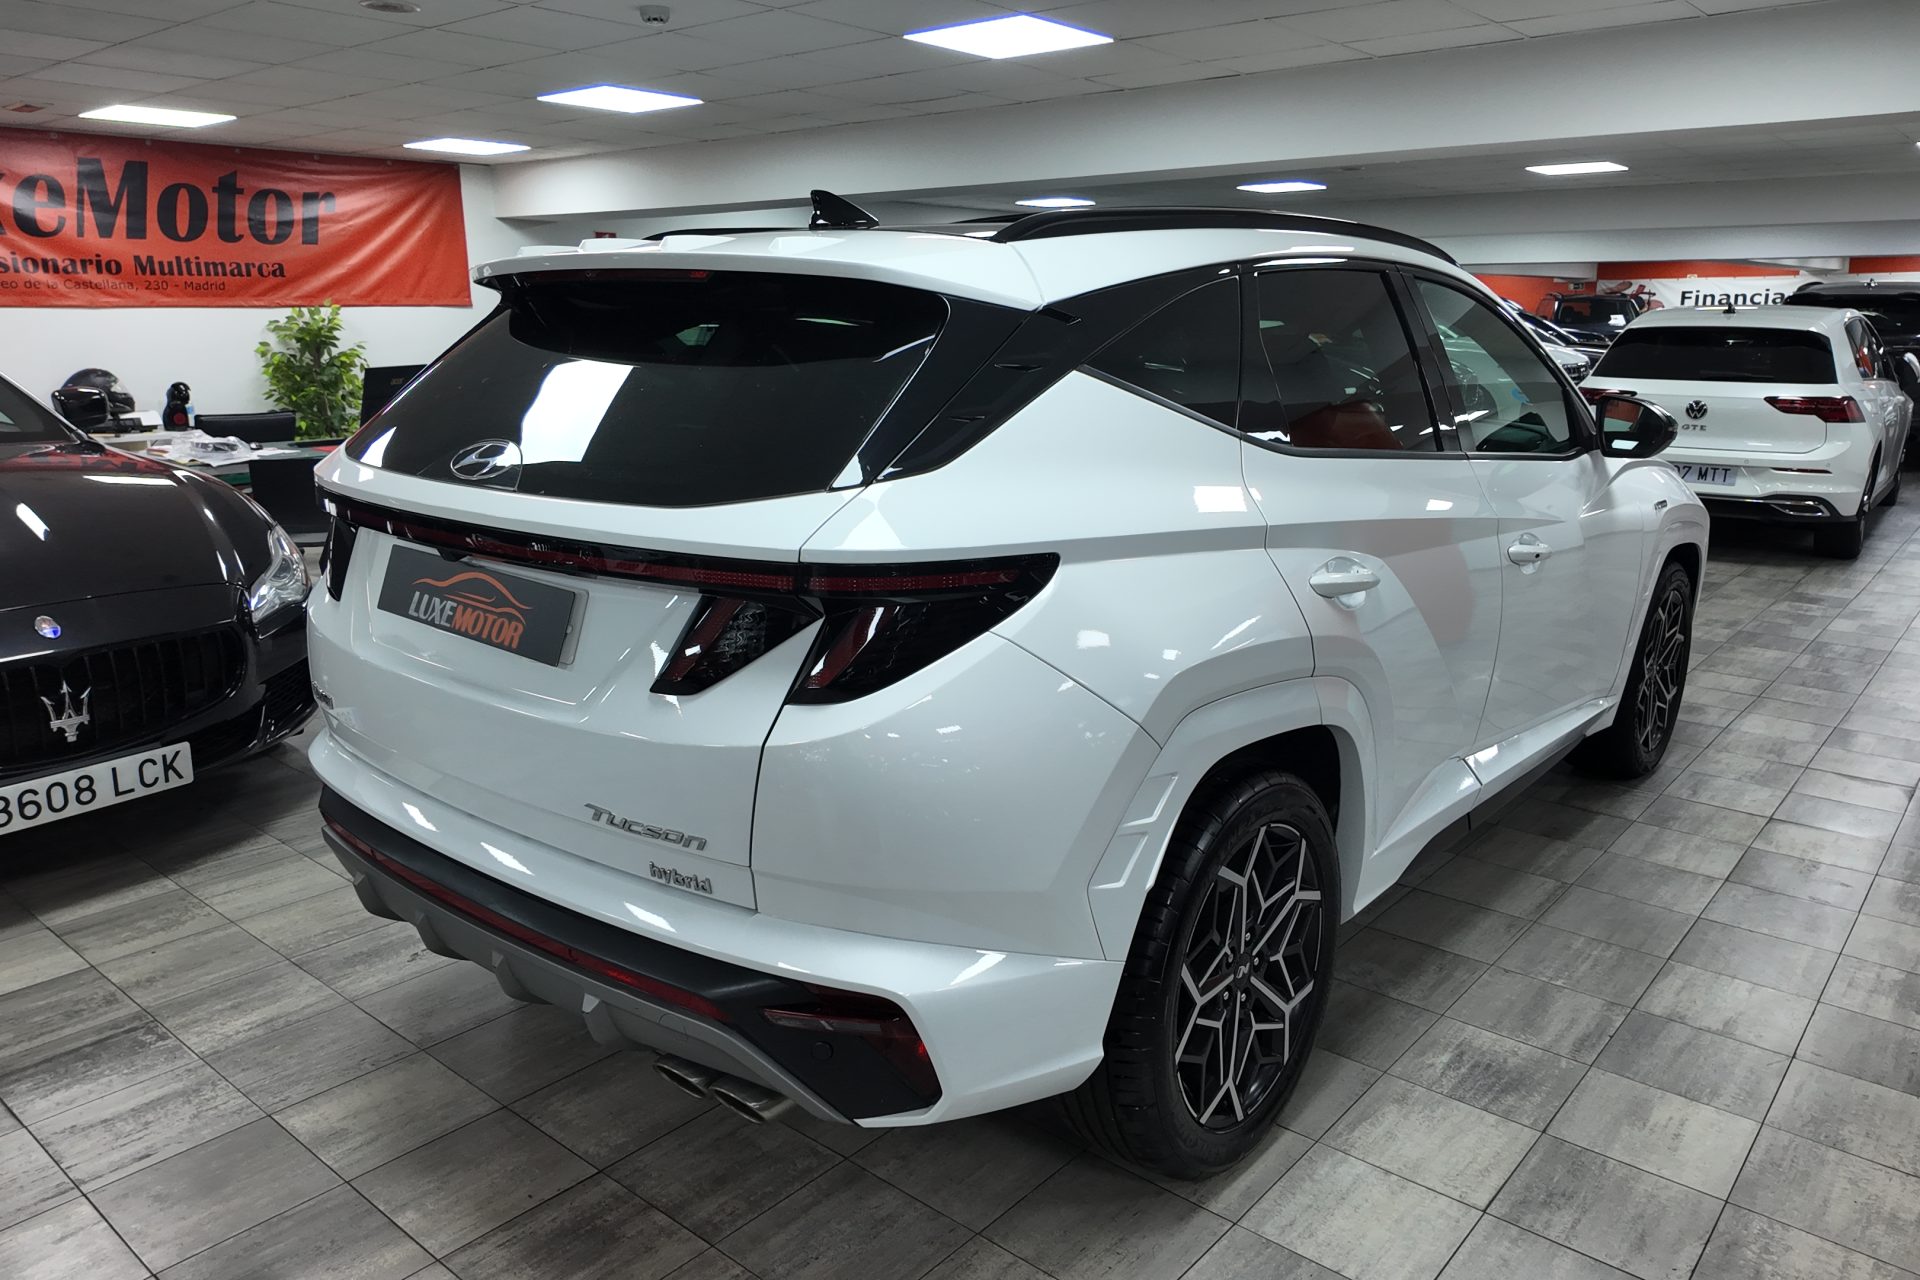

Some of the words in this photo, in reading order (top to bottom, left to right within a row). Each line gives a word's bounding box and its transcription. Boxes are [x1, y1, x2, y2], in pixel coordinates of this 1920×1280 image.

[0, 157, 336, 245] eMotor
[133, 255, 286, 278] Multimarca
[24, 279, 40, 289] de
[47, 279, 58, 289] la
[63, 278, 139, 291] Castellana,
[144, 280, 169, 290] 230
[184, 280, 226, 291] Madrid
[1680, 288, 1786, 306] Financia
[1674, 465, 1692, 479] 7
[1697, 467, 1732, 482] MTT
[408, 591, 524, 649] LUXEMOTOR
[111, 750, 184, 797] LCK
[584, 803, 707, 851] Tucson
[648, 861, 713, 894] hybrid
